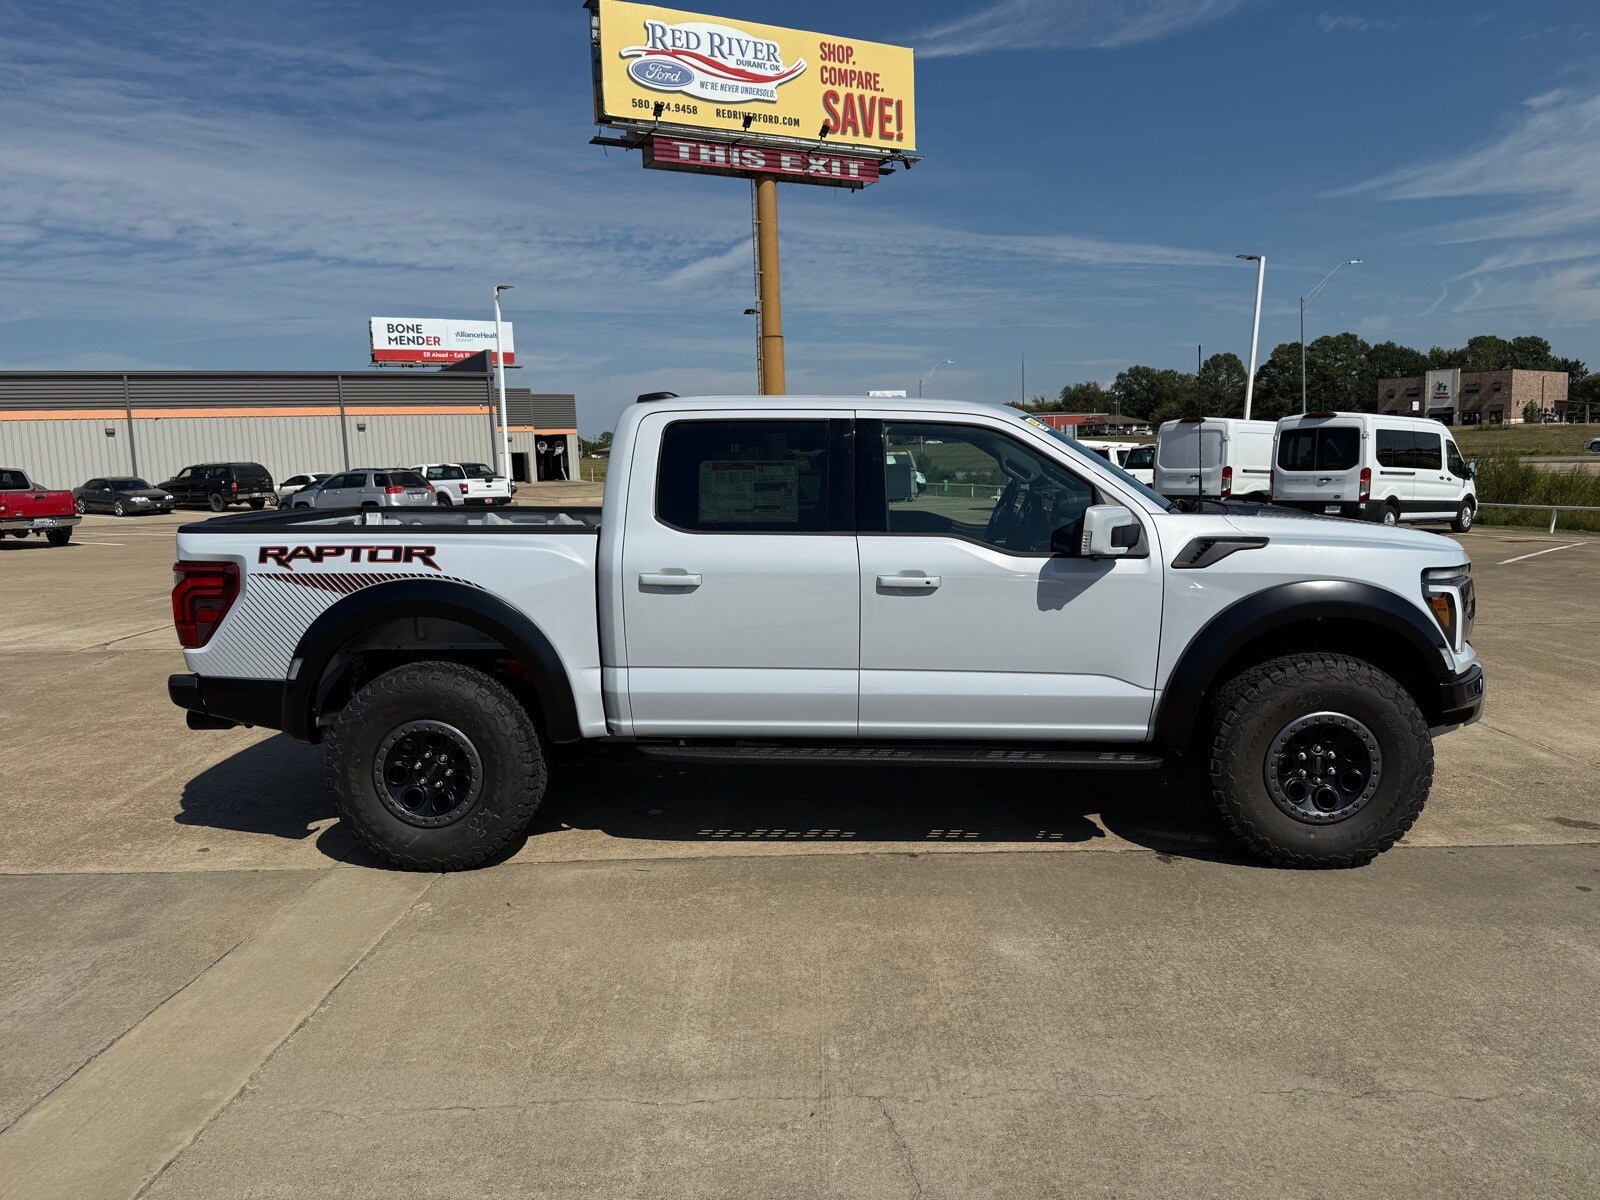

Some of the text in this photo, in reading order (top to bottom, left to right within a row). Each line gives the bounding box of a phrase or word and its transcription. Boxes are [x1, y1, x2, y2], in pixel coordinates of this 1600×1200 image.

[648, 21, 780, 63] RED RIVER
[818, 41, 856, 66] SHOP.
[646, 61, 682, 83] Ford
[735, 58, 781, 72] DURANT, OK
[699, 80, 776, 99] WE'RE NEVER UNDERSOLD.
[819, 65, 885, 93] COMPARE.
[822, 89, 904, 141] SAVE!
[670, 140, 864, 179] THIS EXIT
[386, 323, 423, 334] BONE
[454, 331, 498, 339] AllianceHealt
[387, 335, 441, 346] MENDER
[258, 545, 442, 572] RAPTOR
